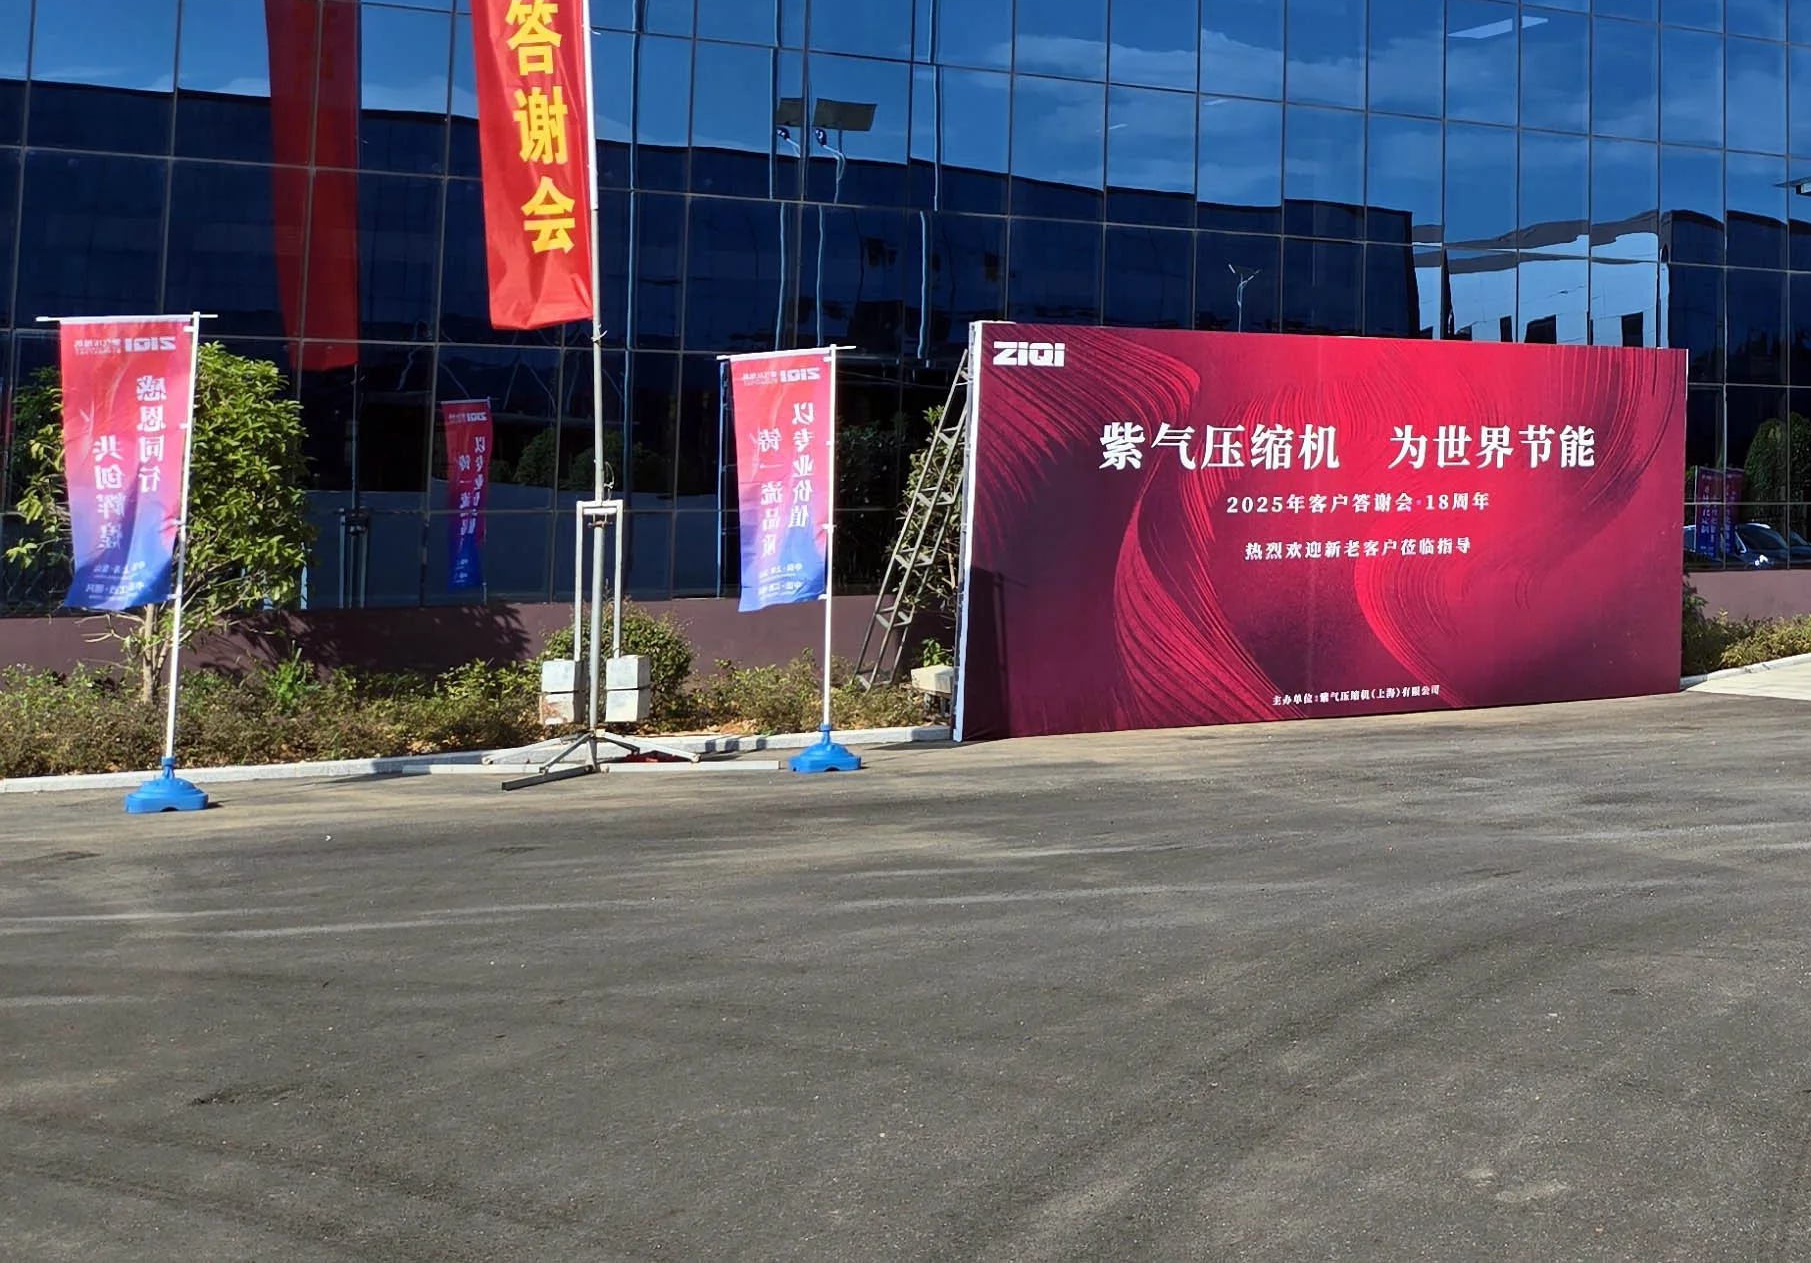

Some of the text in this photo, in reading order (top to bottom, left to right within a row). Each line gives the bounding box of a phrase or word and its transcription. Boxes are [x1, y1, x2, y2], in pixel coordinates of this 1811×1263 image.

[992, 340, 1065, 368] ZIQI
[1098, 422, 1596, 472] 紫气压缩机 为世界节能
[1226, 491, 1491, 515] 2025年客户答谢会·18周年
[1244, 537, 1472, 561] 热烈欢迎新老客户莅临指导
